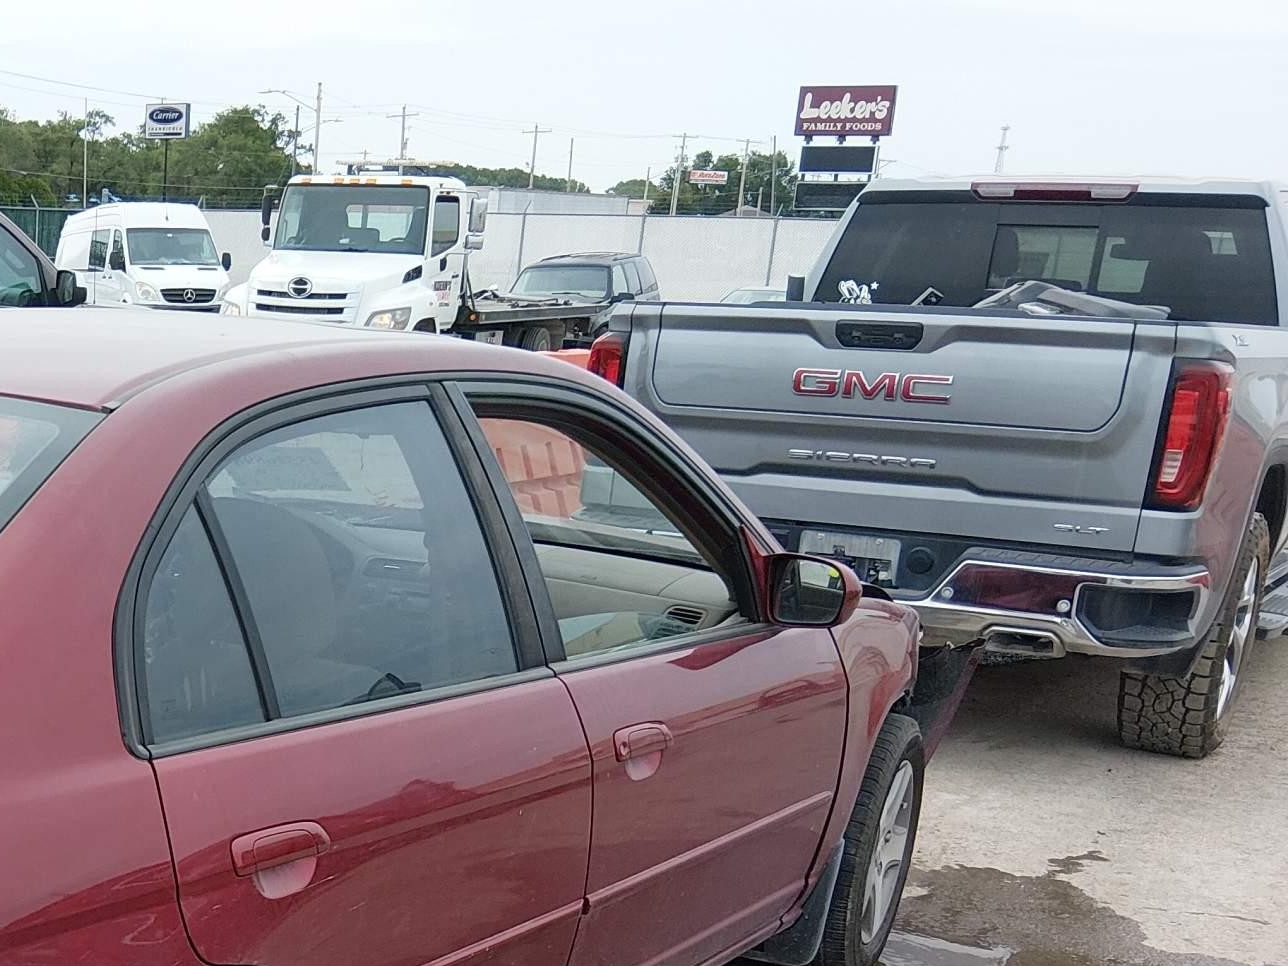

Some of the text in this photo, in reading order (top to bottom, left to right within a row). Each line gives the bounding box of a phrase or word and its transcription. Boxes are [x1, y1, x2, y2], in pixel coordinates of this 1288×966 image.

[799, 92, 890, 119] Leeker's
[153, 111, 179, 120] Carrier
[802, 122, 882, 131] FAMILY FOODS
[792, 367, 954, 404] GMC
[787, 448, 937, 470] SIERRA
[1053, 523, 1111, 535] SLT
